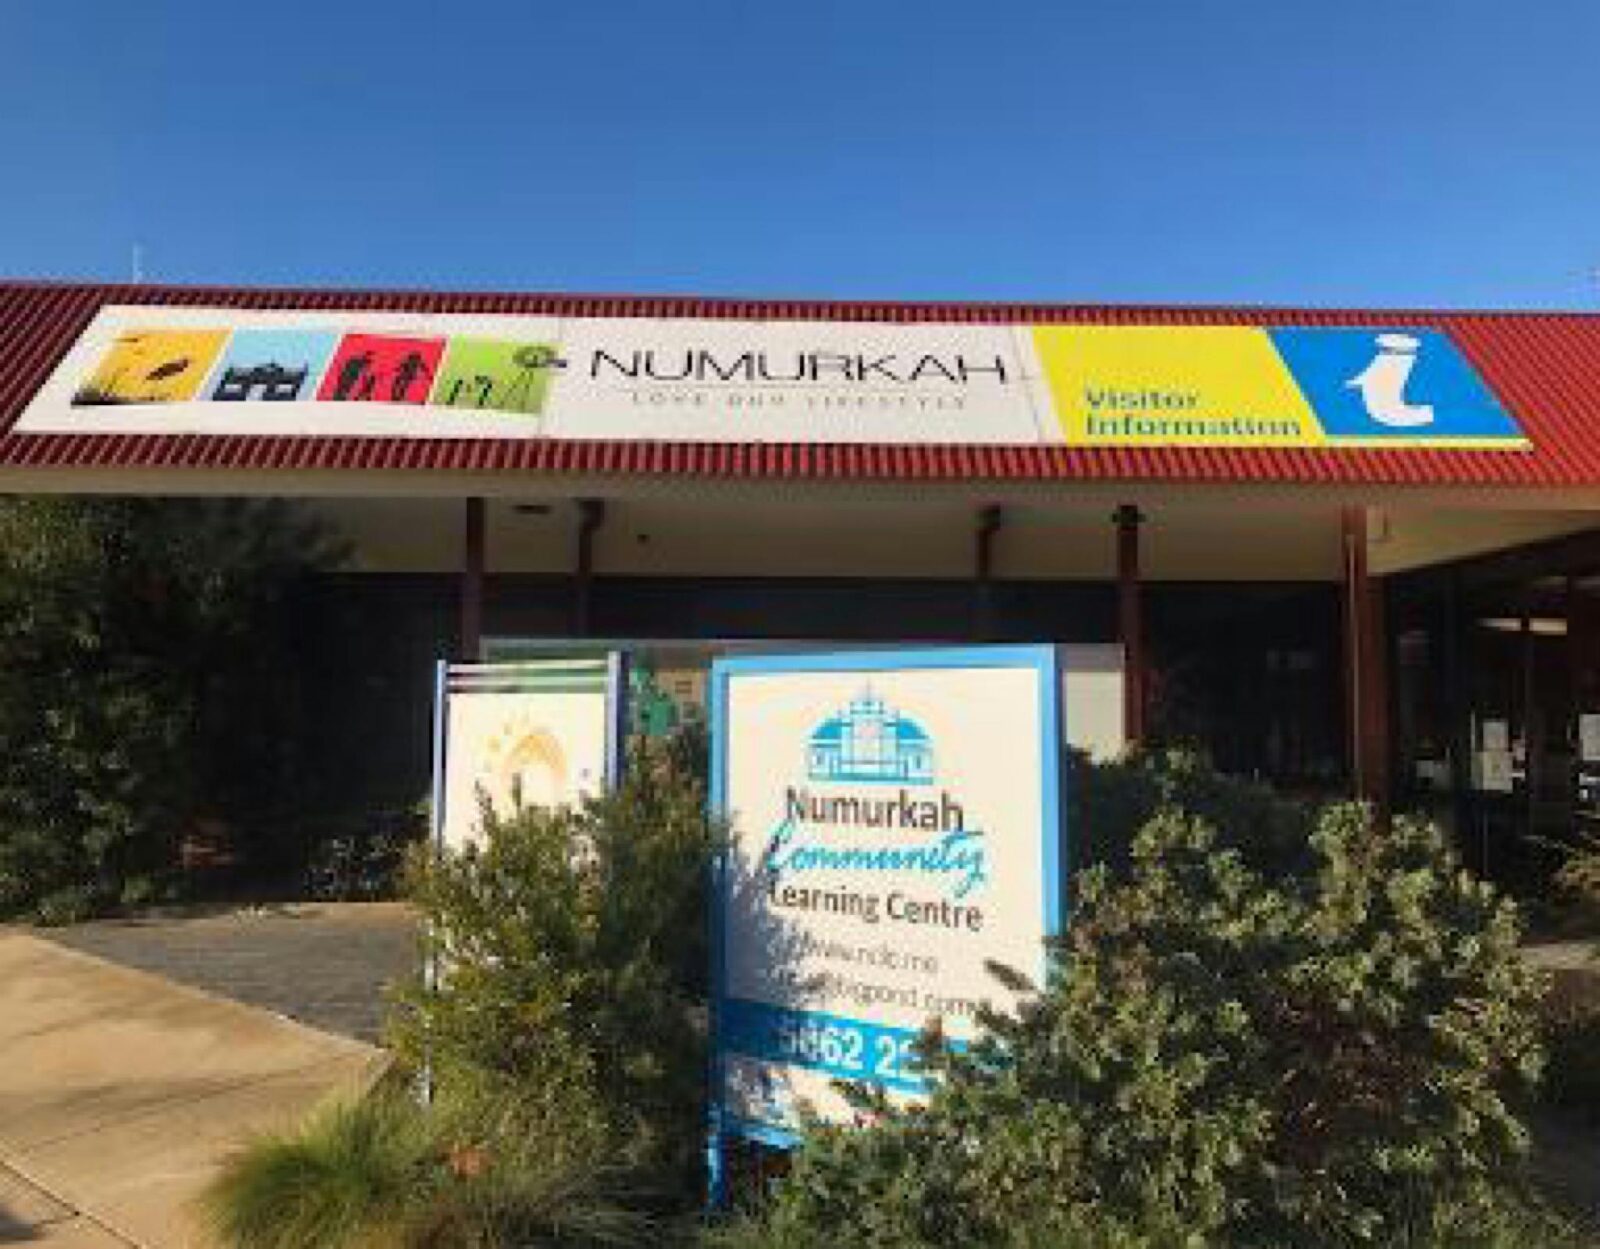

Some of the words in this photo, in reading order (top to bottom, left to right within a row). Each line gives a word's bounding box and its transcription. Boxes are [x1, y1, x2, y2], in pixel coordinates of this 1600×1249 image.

[590, 348, 1006, 384] NUMURKAH
[1085, 388, 1202, 409] Visitor
[1085, 413, 1302, 436] Information
[785, 785, 965, 832] Numurkah
[766, 817, 985, 898] Community
[767, 878, 880, 924] Learning
[886, 891, 985, 933] Centre
